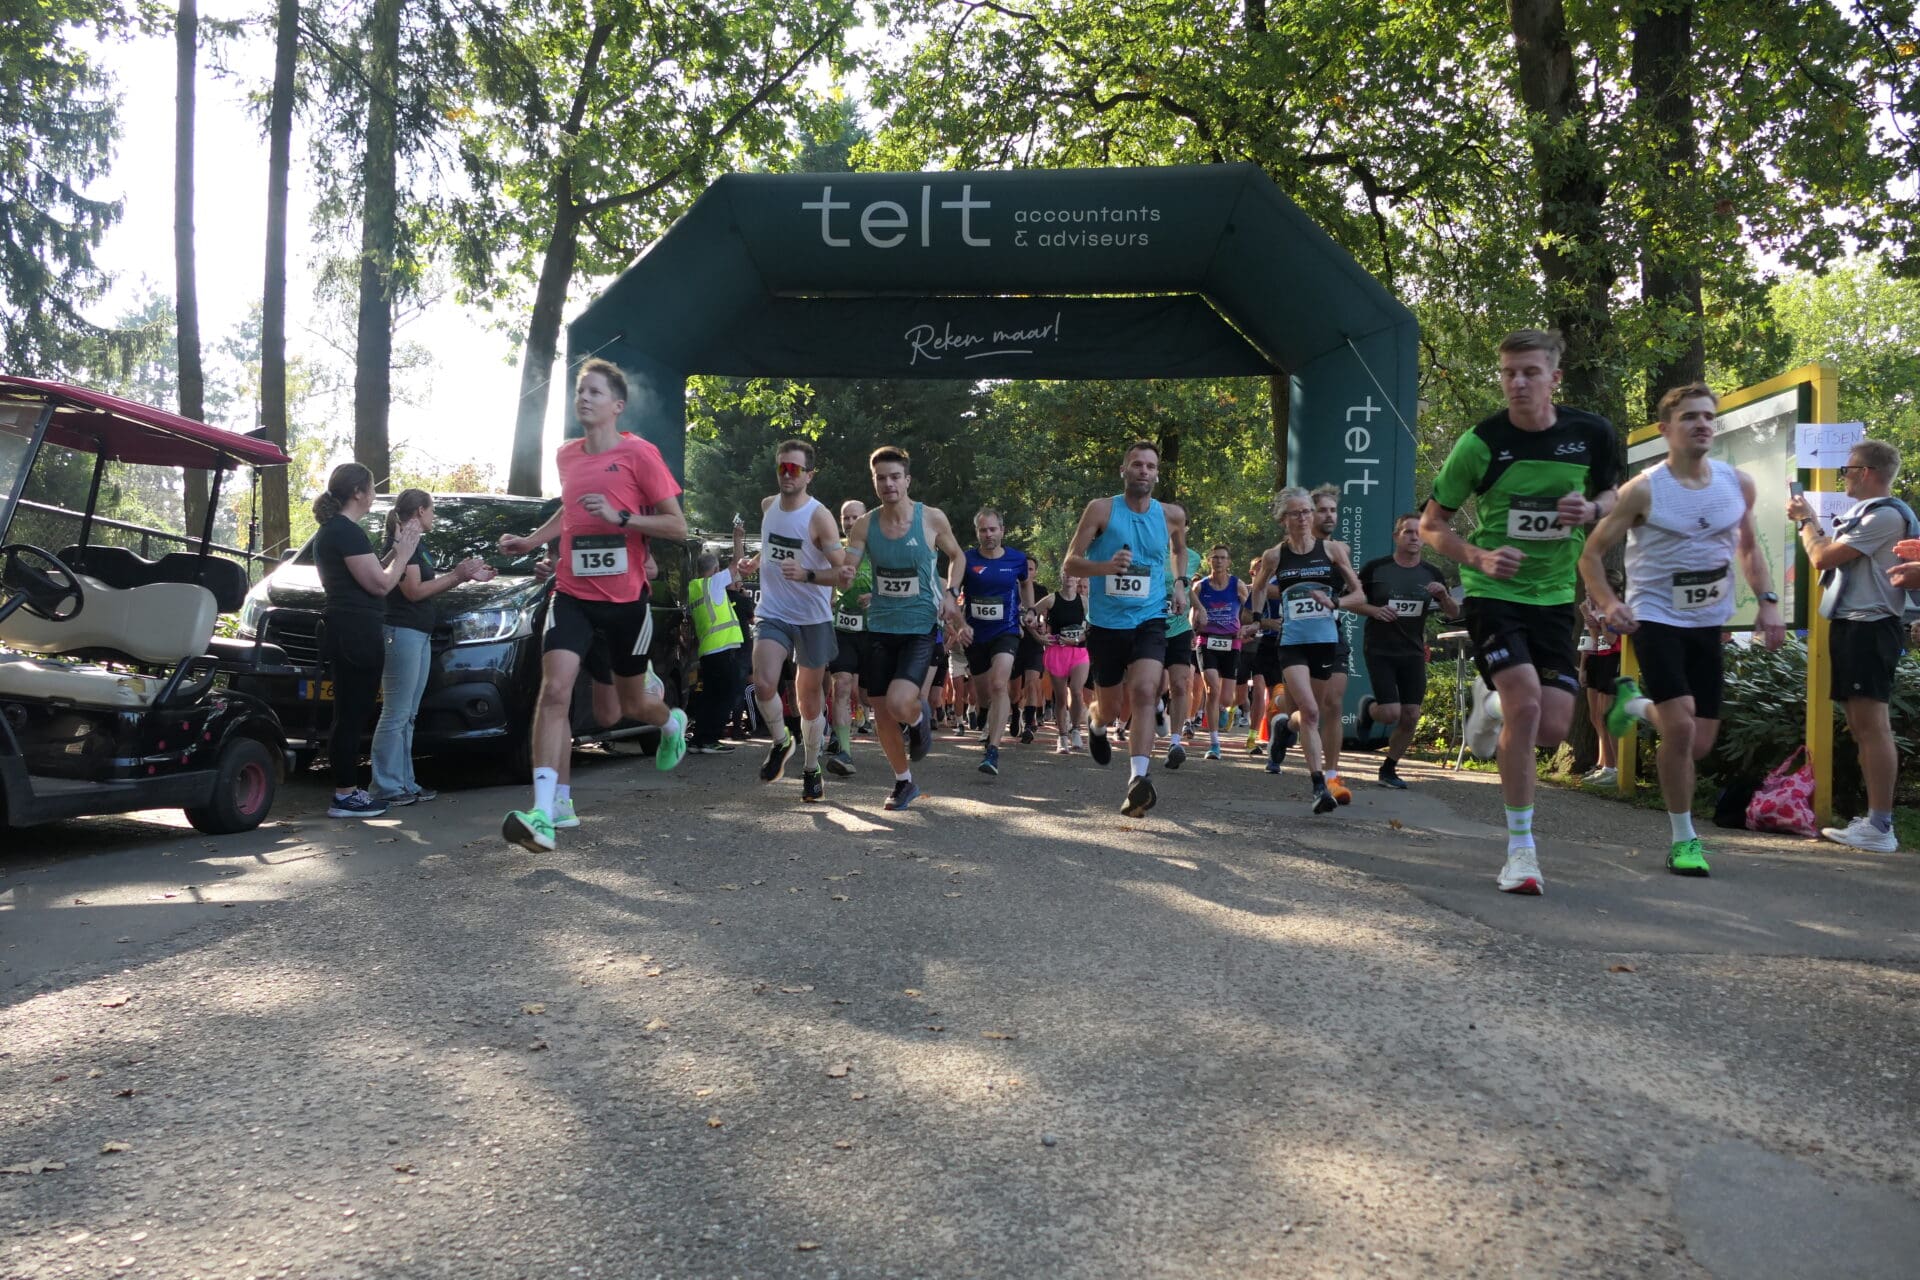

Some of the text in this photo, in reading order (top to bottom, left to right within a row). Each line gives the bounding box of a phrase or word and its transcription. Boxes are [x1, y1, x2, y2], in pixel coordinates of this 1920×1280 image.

[802, 184, 991, 249] telt
[1014, 206, 1161, 222] accountants
[1014, 230, 1149, 247] & adviseurs
[904, 312, 1061, 366] Reken maar!
[1343, 396, 1382, 495] telt
[1354, 506, 1364, 574] accountan
[581, 553, 615, 568] 136
[884, 580, 911, 592] 237
[1114, 578, 1142, 591] 130
[1684, 586, 1719, 604] 194
[976, 606, 997, 616] 166
[1295, 602, 1324, 614] 230
[1396, 602, 1417, 613] 197
[839, 616, 857, 627] 200
[1211, 640, 1228, 648] 233
[1341, 712, 1358, 724] elt
